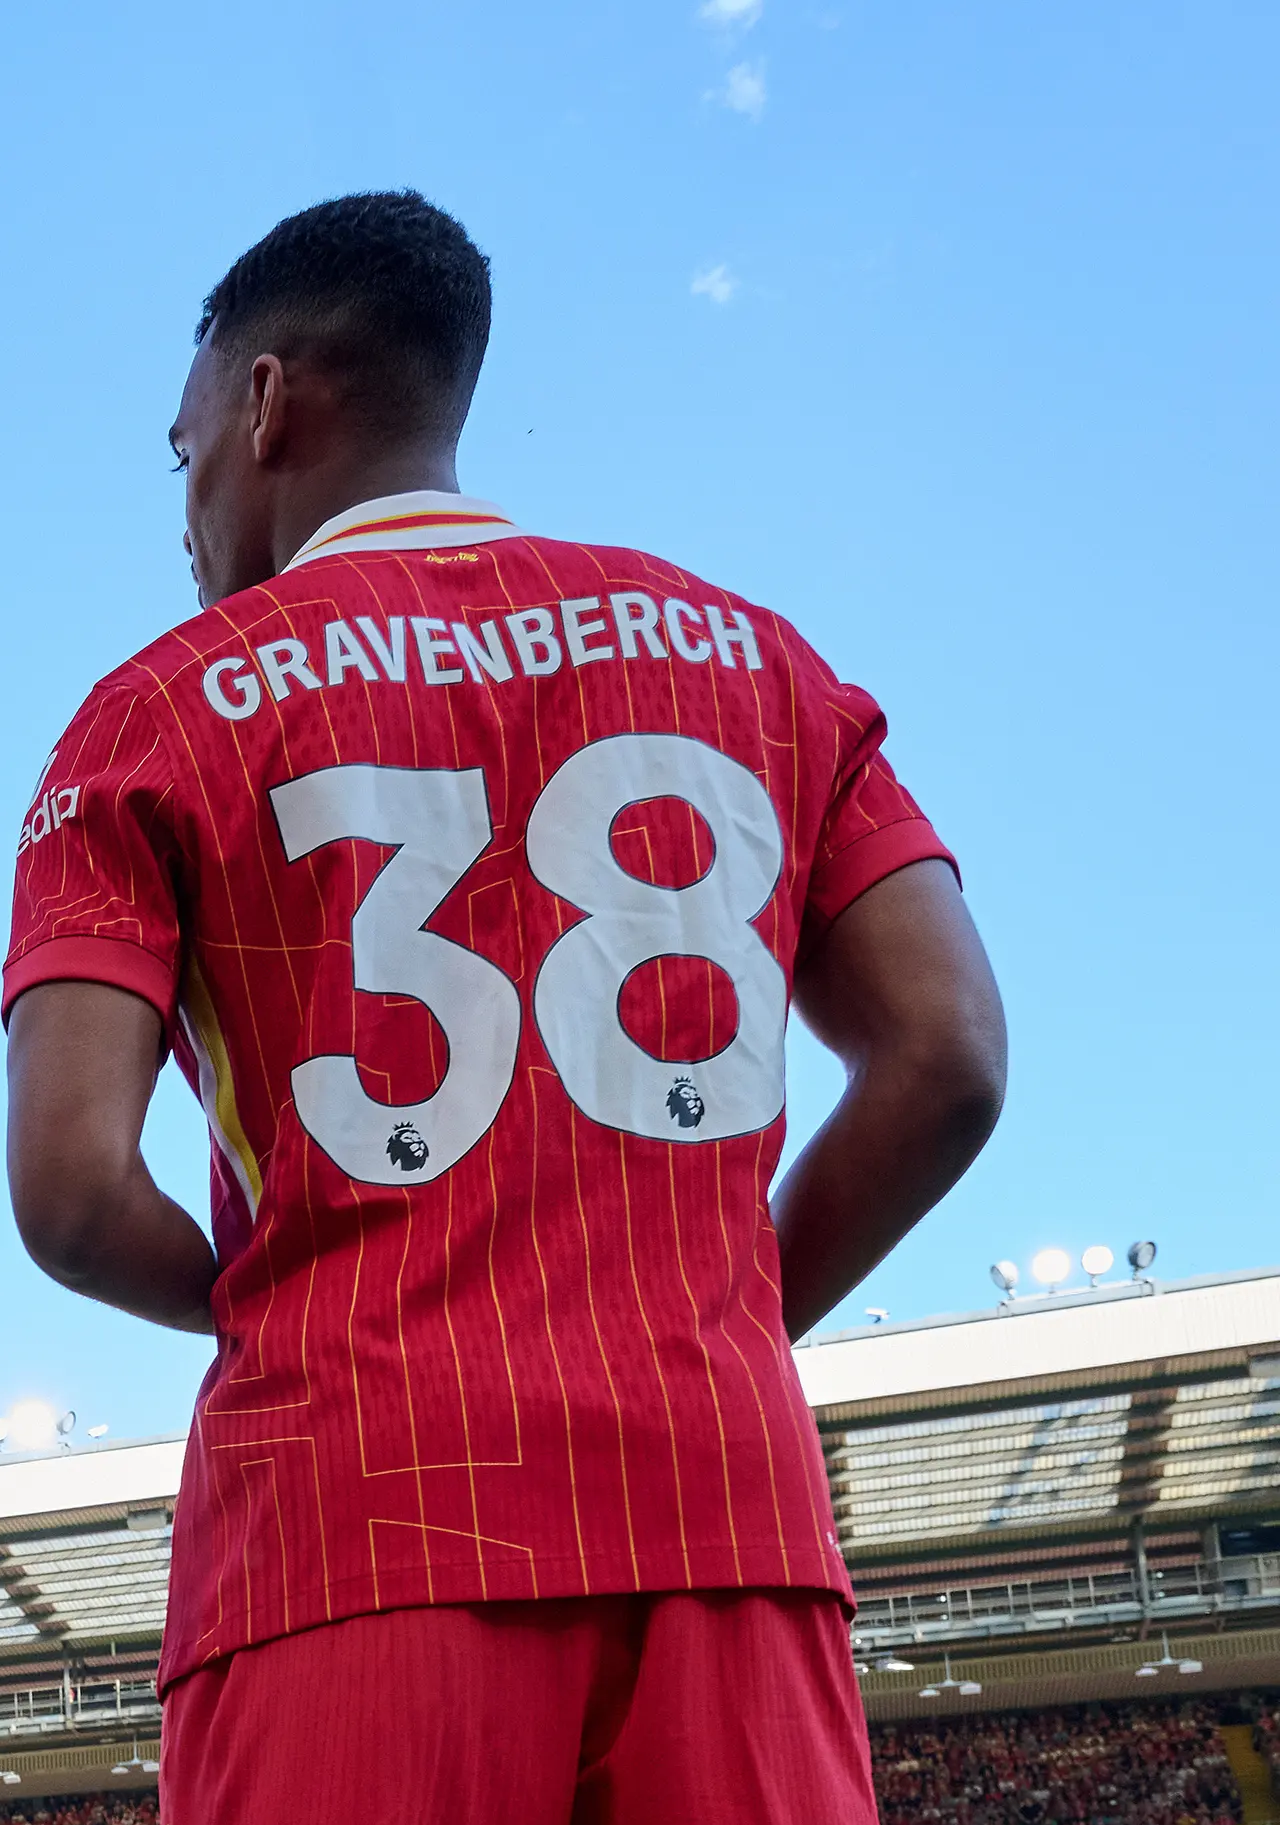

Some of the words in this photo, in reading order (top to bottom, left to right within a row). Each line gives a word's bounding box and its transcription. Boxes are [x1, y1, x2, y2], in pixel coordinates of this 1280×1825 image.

[201, 590, 765, 721] GRAVENBERCH
[17, 785, 81, 858] edia
[269, 731, 786, 1186] 38
